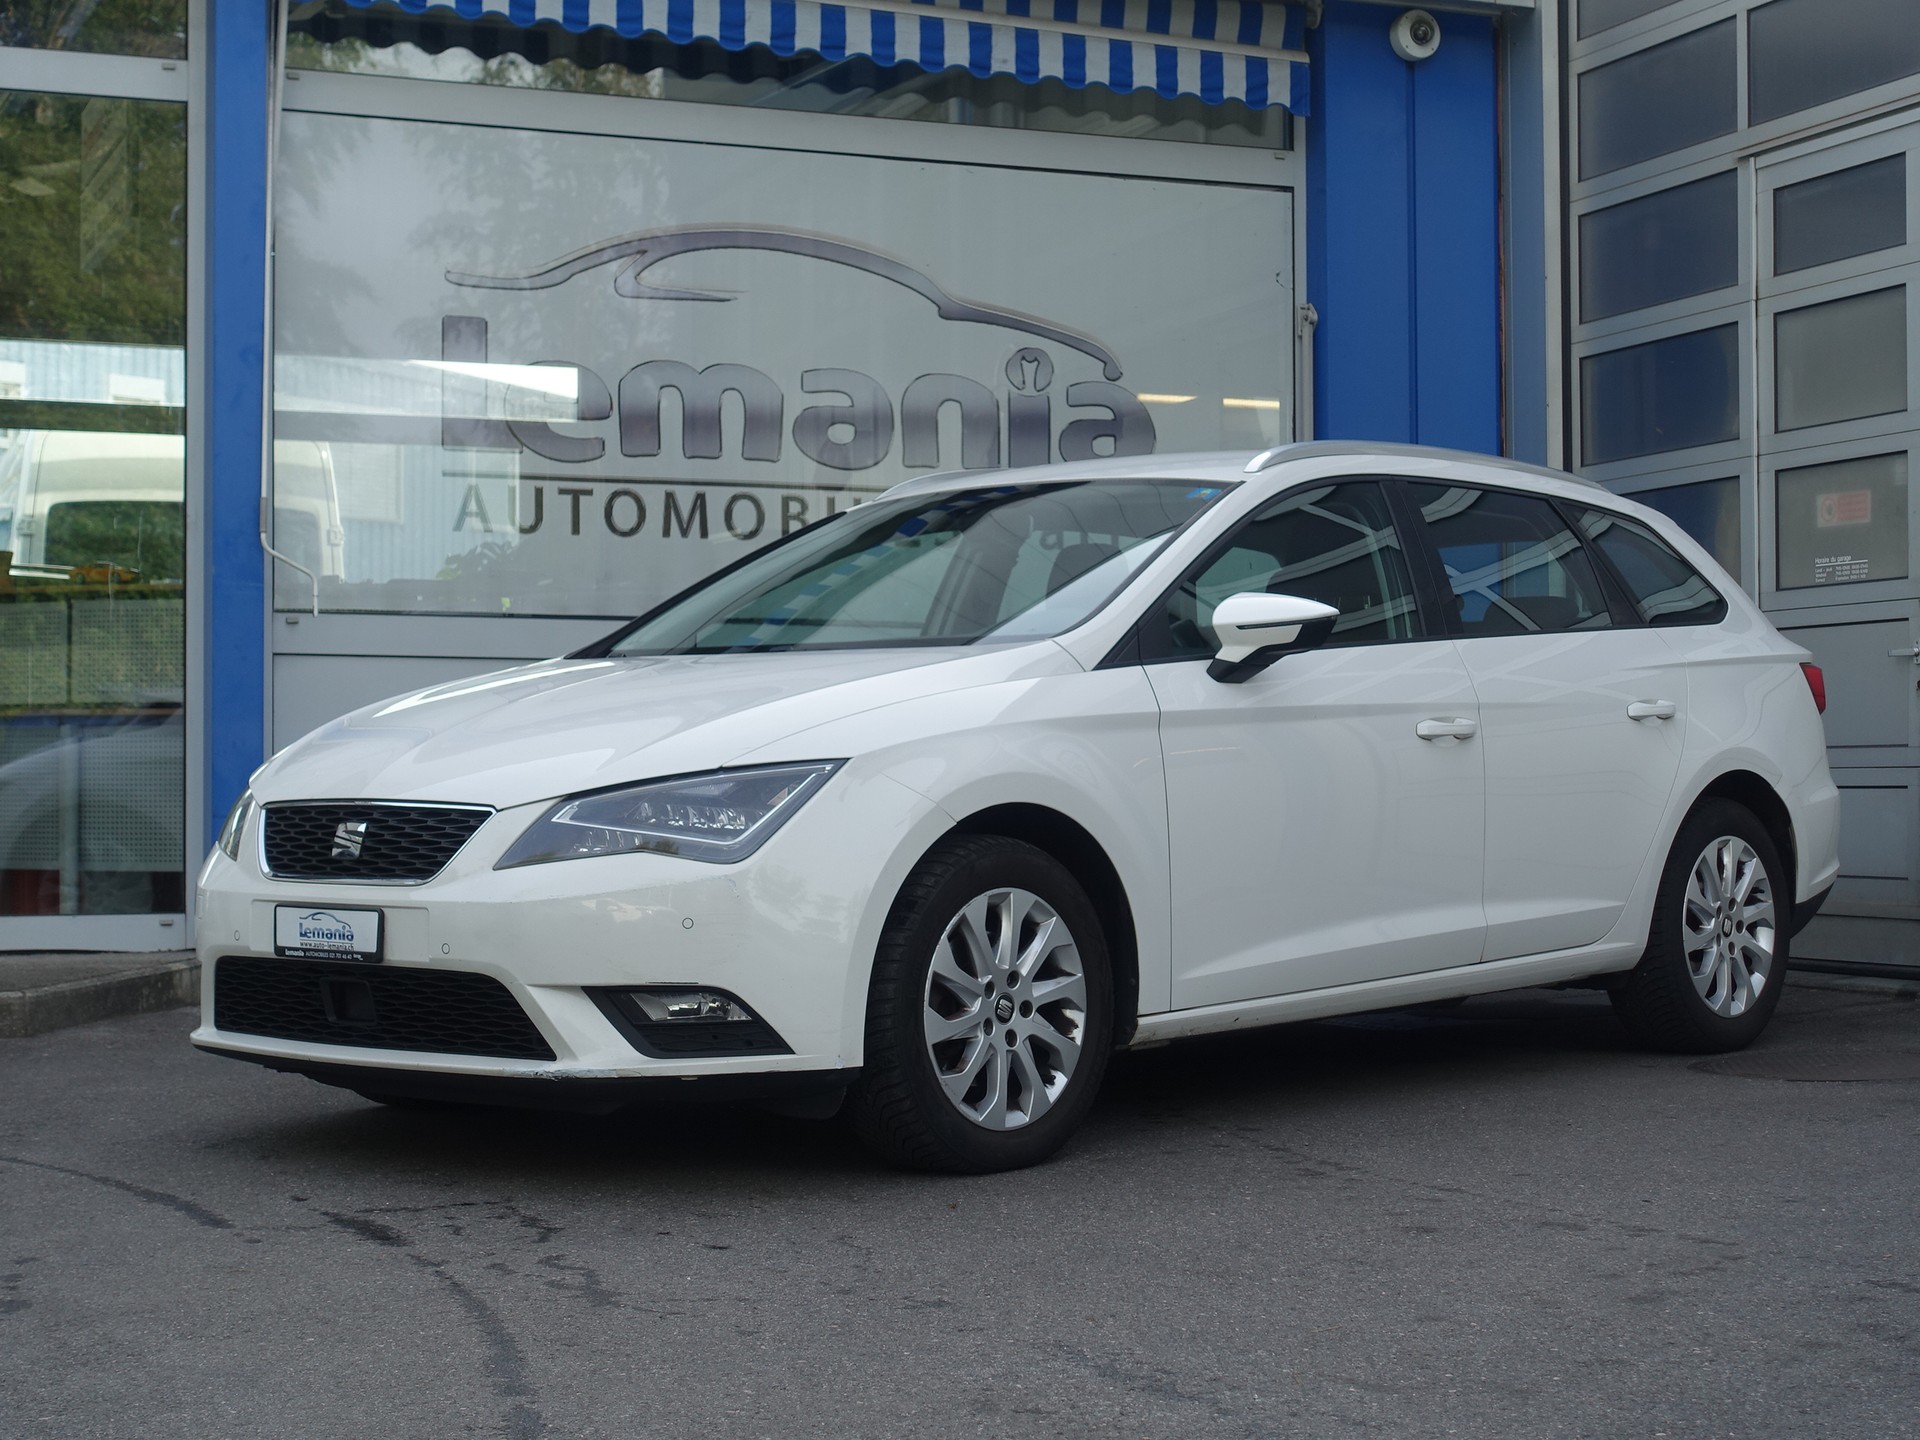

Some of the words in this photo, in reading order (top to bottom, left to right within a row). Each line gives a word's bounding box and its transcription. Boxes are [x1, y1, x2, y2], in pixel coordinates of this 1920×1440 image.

[442, 315, 1157, 470] Lemania
[452, 484, 862, 542] AUTOMOB
[299, 922, 354, 942] Lemania
